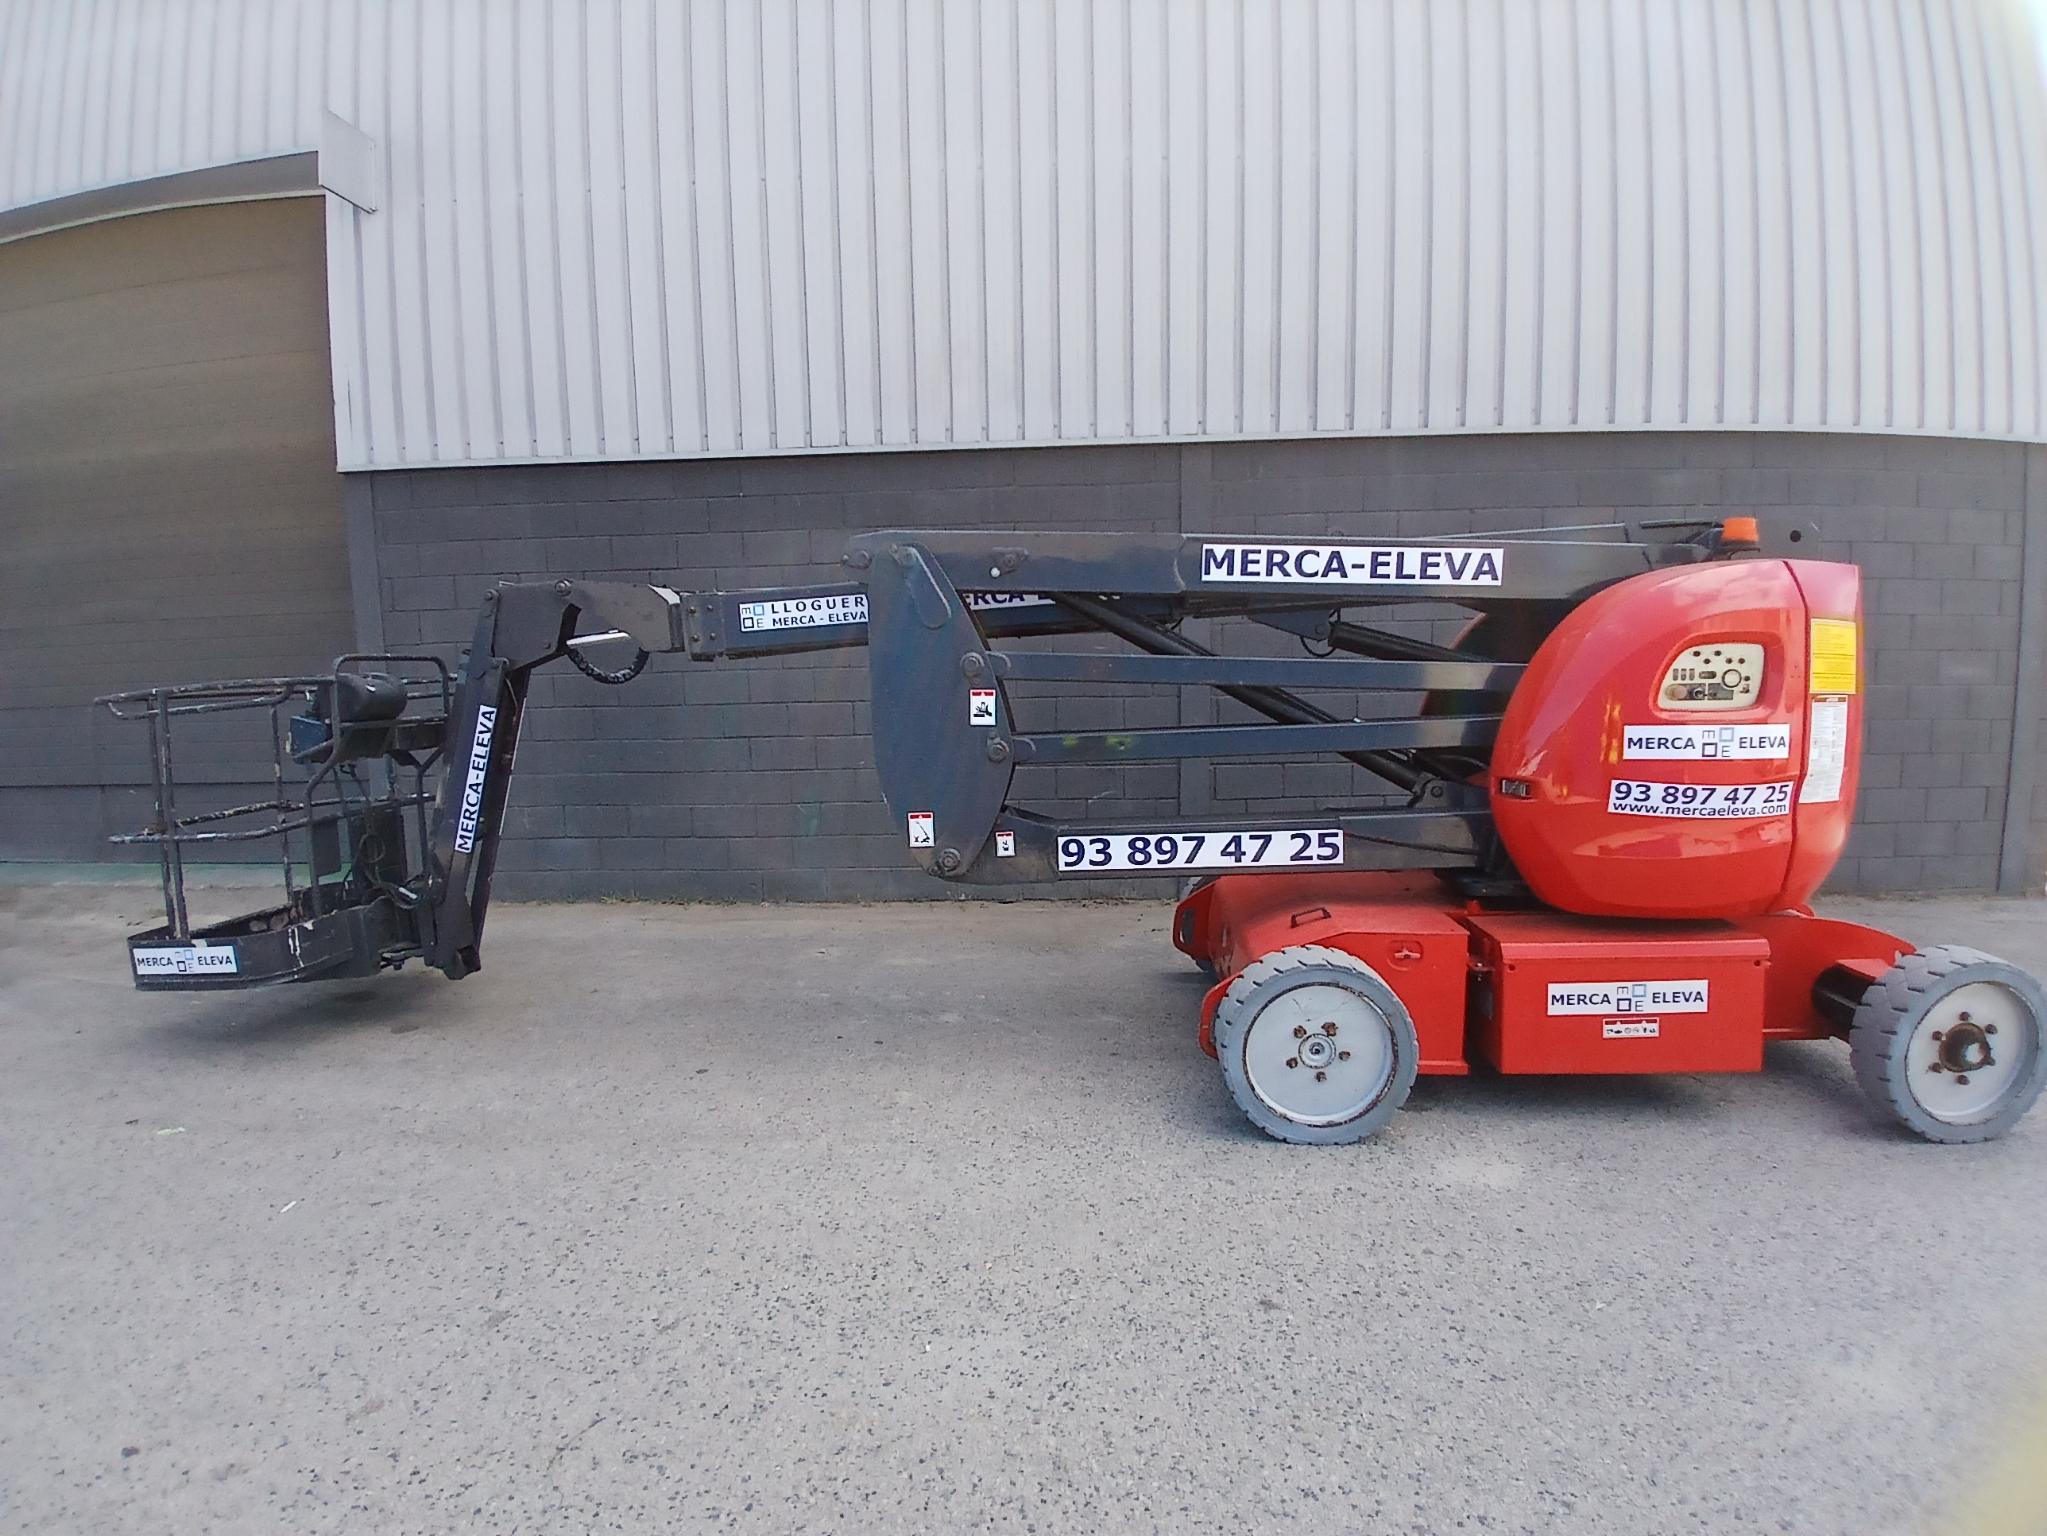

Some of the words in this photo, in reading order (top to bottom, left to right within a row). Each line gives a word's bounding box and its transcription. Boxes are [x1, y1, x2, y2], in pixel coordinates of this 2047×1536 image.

[1203, 548, 1499, 581] MERCA-ELEVA
[771, 596, 865, 614] LLOGUER
[772, 614, 816, 627] MERCA
[828, 611, 867, 623] ELEVA
[1627, 737, 1696, 750] MERCA
[1739, 736, 1786, 749] ELEVA
[457, 710, 496, 851] MERCA-ELEVA
[1614, 782, 1651, 802] 93
[1661, 785, 1717, 805] 897
[1724, 787, 1757, 805] 47
[1763, 784, 1789, 803] 25
[1613, 801, 1787, 816] www.mercaeleva.com
[1060, 837, 1113, 868] 93
[1127, 835, 1206, 866] 897
[1220, 834, 1273, 863] 47
[1290, 832, 1340, 862] 25
[136, 956, 174, 967] MERCA
[197, 955, 233, 966] ELEVA
[1551, 993, 1612, 1006] MERCA
[1652, 991, 1704, 1004] ELEVA
